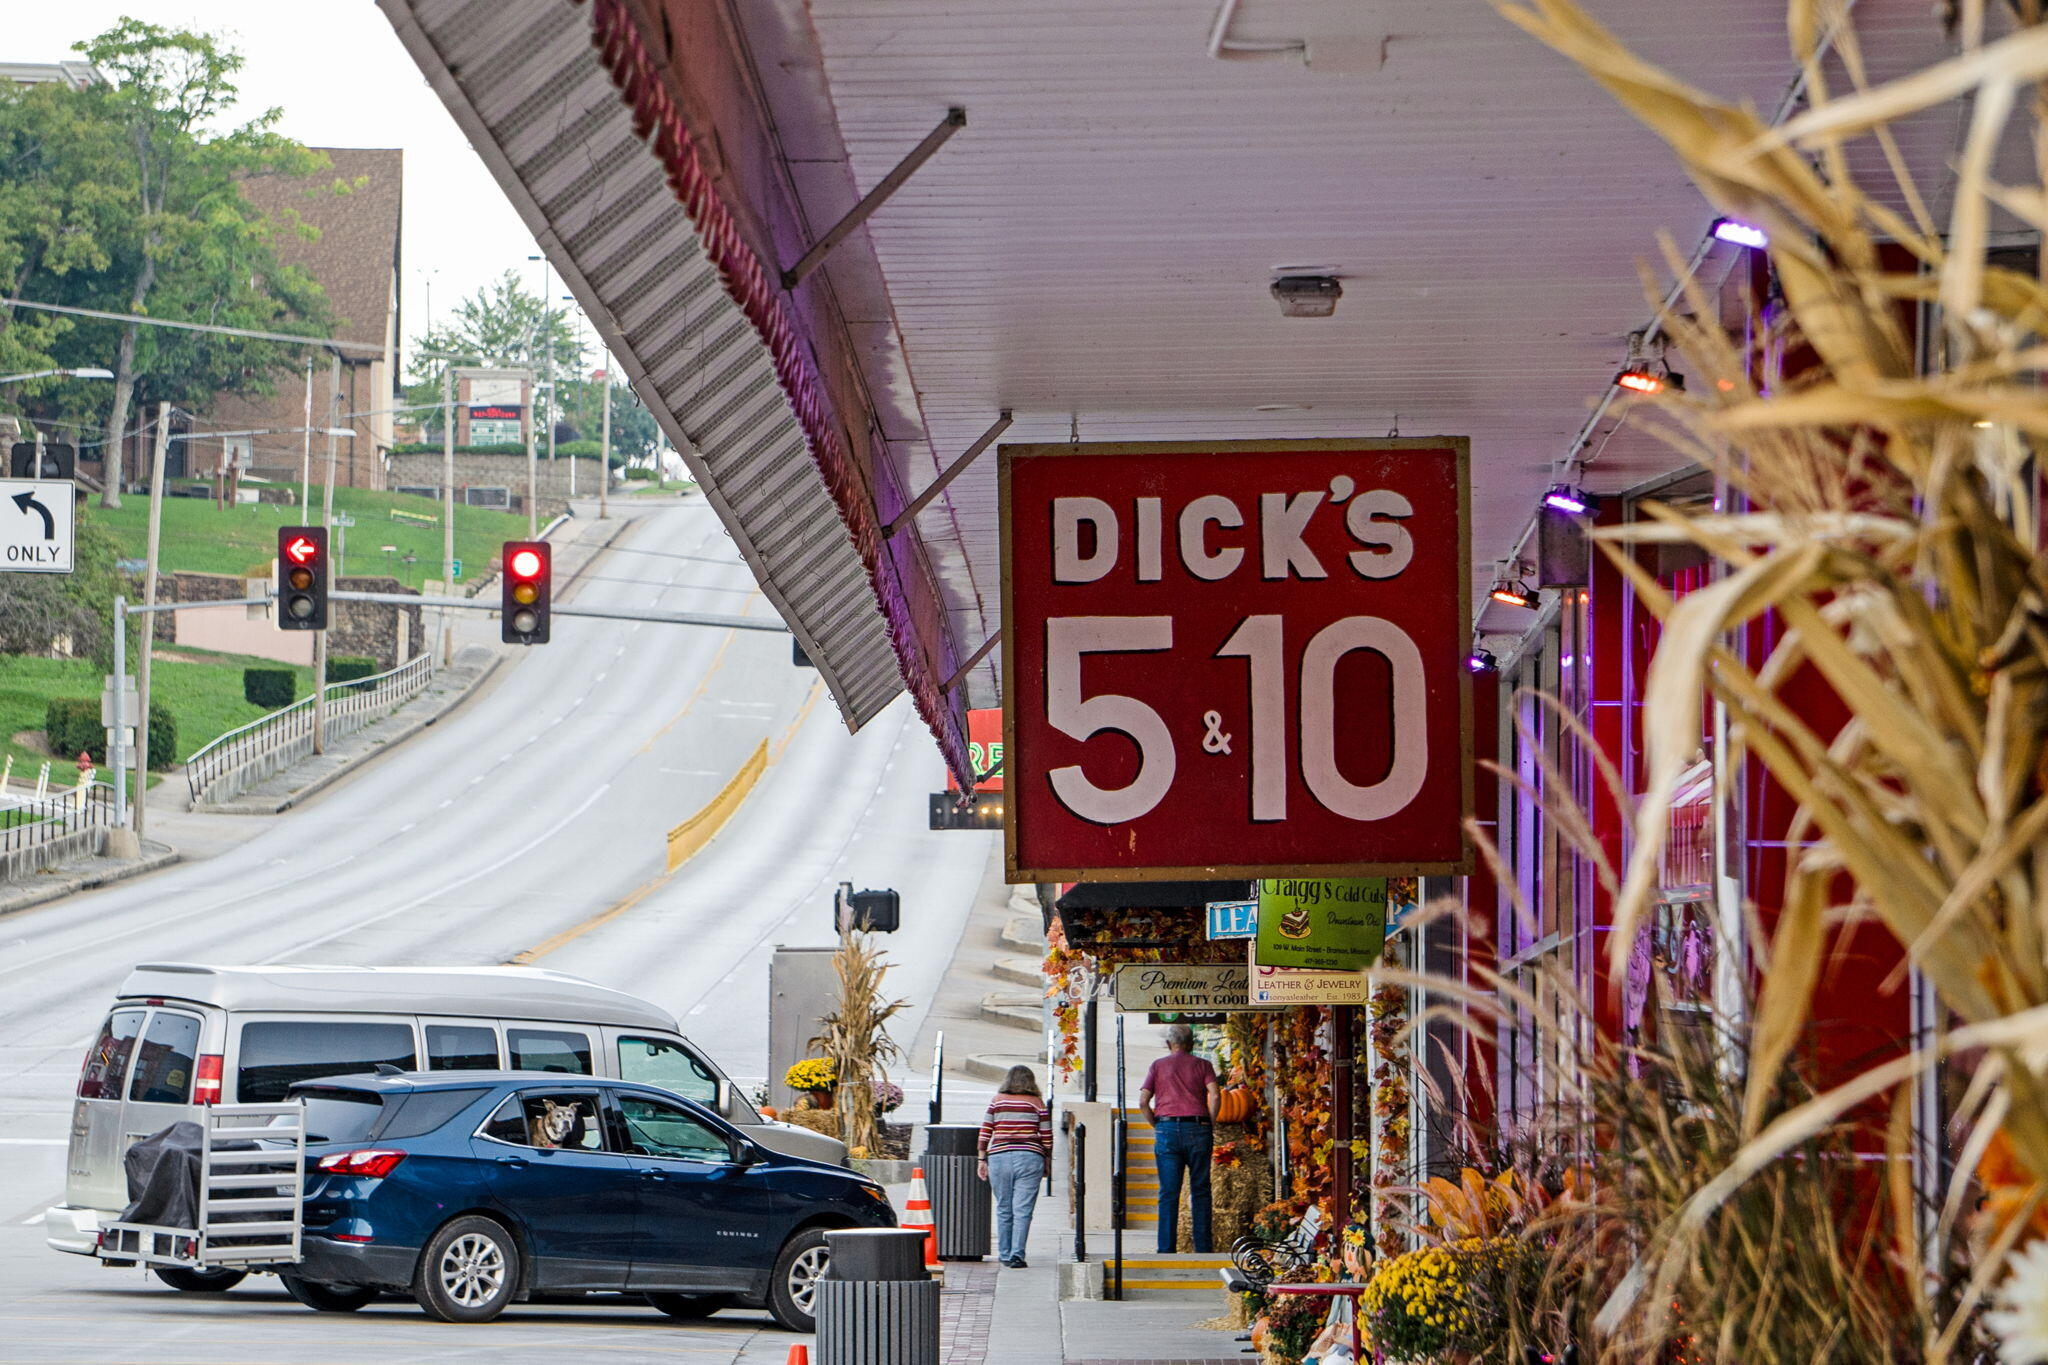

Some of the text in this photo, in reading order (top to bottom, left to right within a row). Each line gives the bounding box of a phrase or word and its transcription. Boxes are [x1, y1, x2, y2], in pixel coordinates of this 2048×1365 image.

[1051, 475, 1415, 584] DICK'S
[7, 545, 60, 562] ONLY
[1046, 614, 1429, 825] 5 & 10
[1335, 886, 1359, 902] Cold
[1361, 888, 1385, 904] Cuts
[1291, 944, 1305, 953] Main
[1140, 970, 1208, 991] Premium
[1258, 979, 1361, 990] LEATHER & JEWELRY
[1153, 995, 1211, 1007] QUALITY
[1269, 992, 1319, 1001] sonyasleather
[1326, 992, 1340, 1000] Est.
[1343, 992, 1361, 1000] 1983
